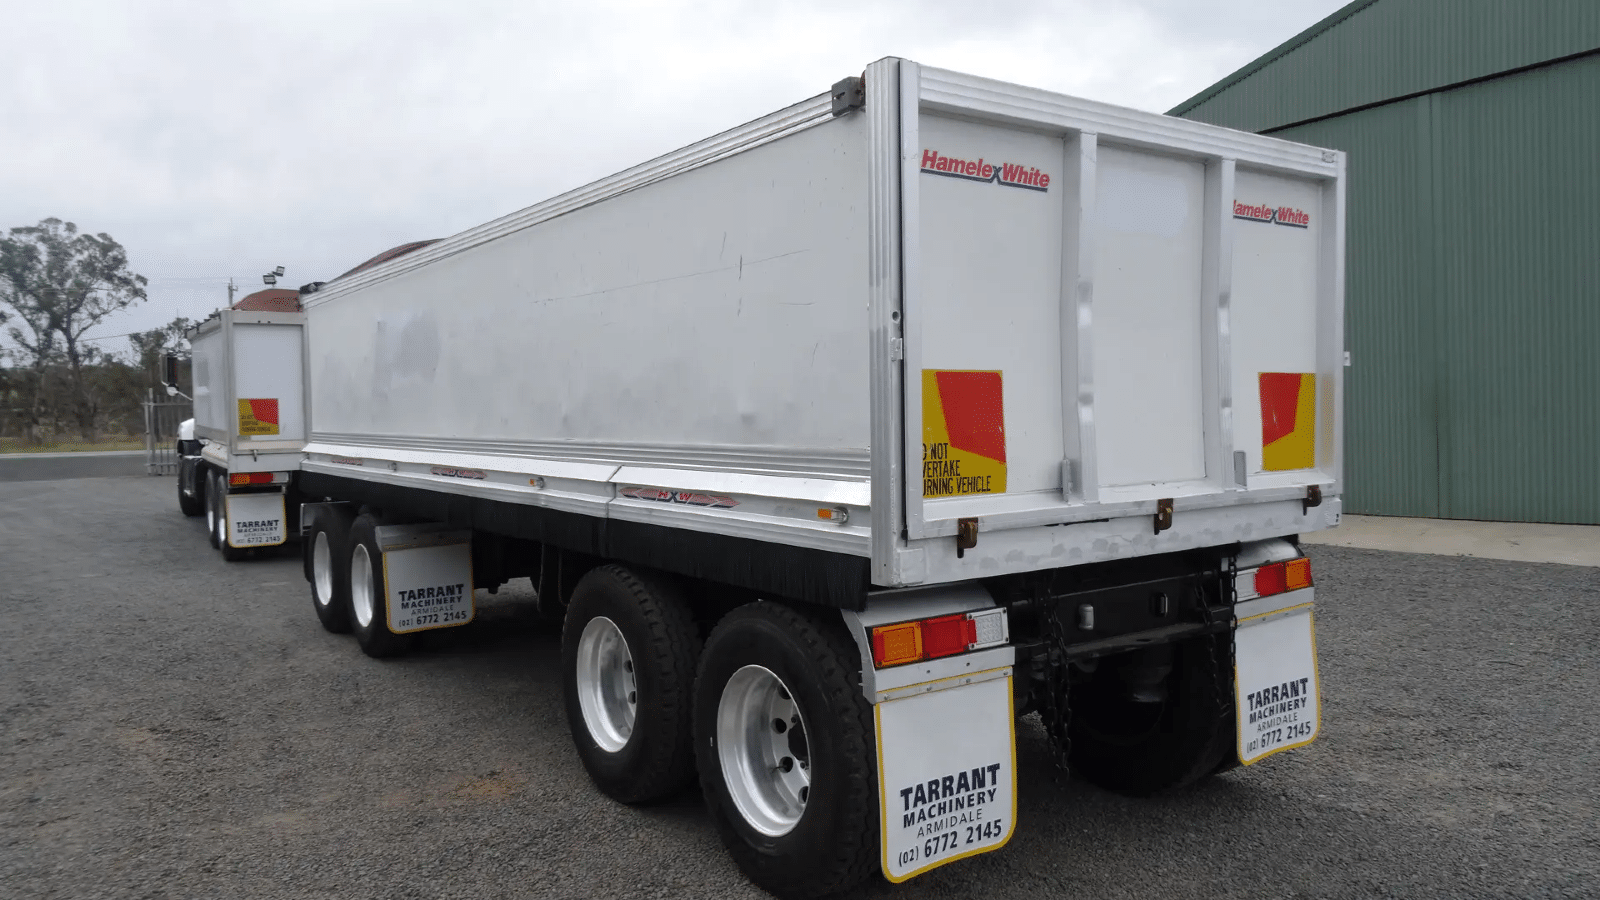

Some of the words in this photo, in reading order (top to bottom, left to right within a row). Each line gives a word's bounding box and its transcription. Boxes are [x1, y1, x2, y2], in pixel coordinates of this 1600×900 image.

[930, 443, 948, 459] NOT
[956, 475, 991, 493] VEHICLE
[236, 519, 280, 529] TARRANT
[398, 583, 464, 602] TARRANT
[401, 596, 462, 610] MACHINERY
[411, 605, 454, 616] ARMIDALE
[416, 614, 439, 625] 6772
[443, 611, 467, 622] 2145
[1247, 677, 1309, 711] TARRANT
[1249, 697, 1307, 724] MACHINERY
[1257, 712, 1298, 733] ARMIDALE
[1261, 728, 1282, 748] 6772
[1286, 721, 1311, 740] 2145
[900, 763, 1001, 812] TARRANT
[903, 788, 997, 829] MACHINERY
[916, 808, 983, 838] ARMIDALE
[898, 845, 919, 867] (02)
[924, 830, 958, 858] 6772
[965, 819, 1002, 844] 2145
